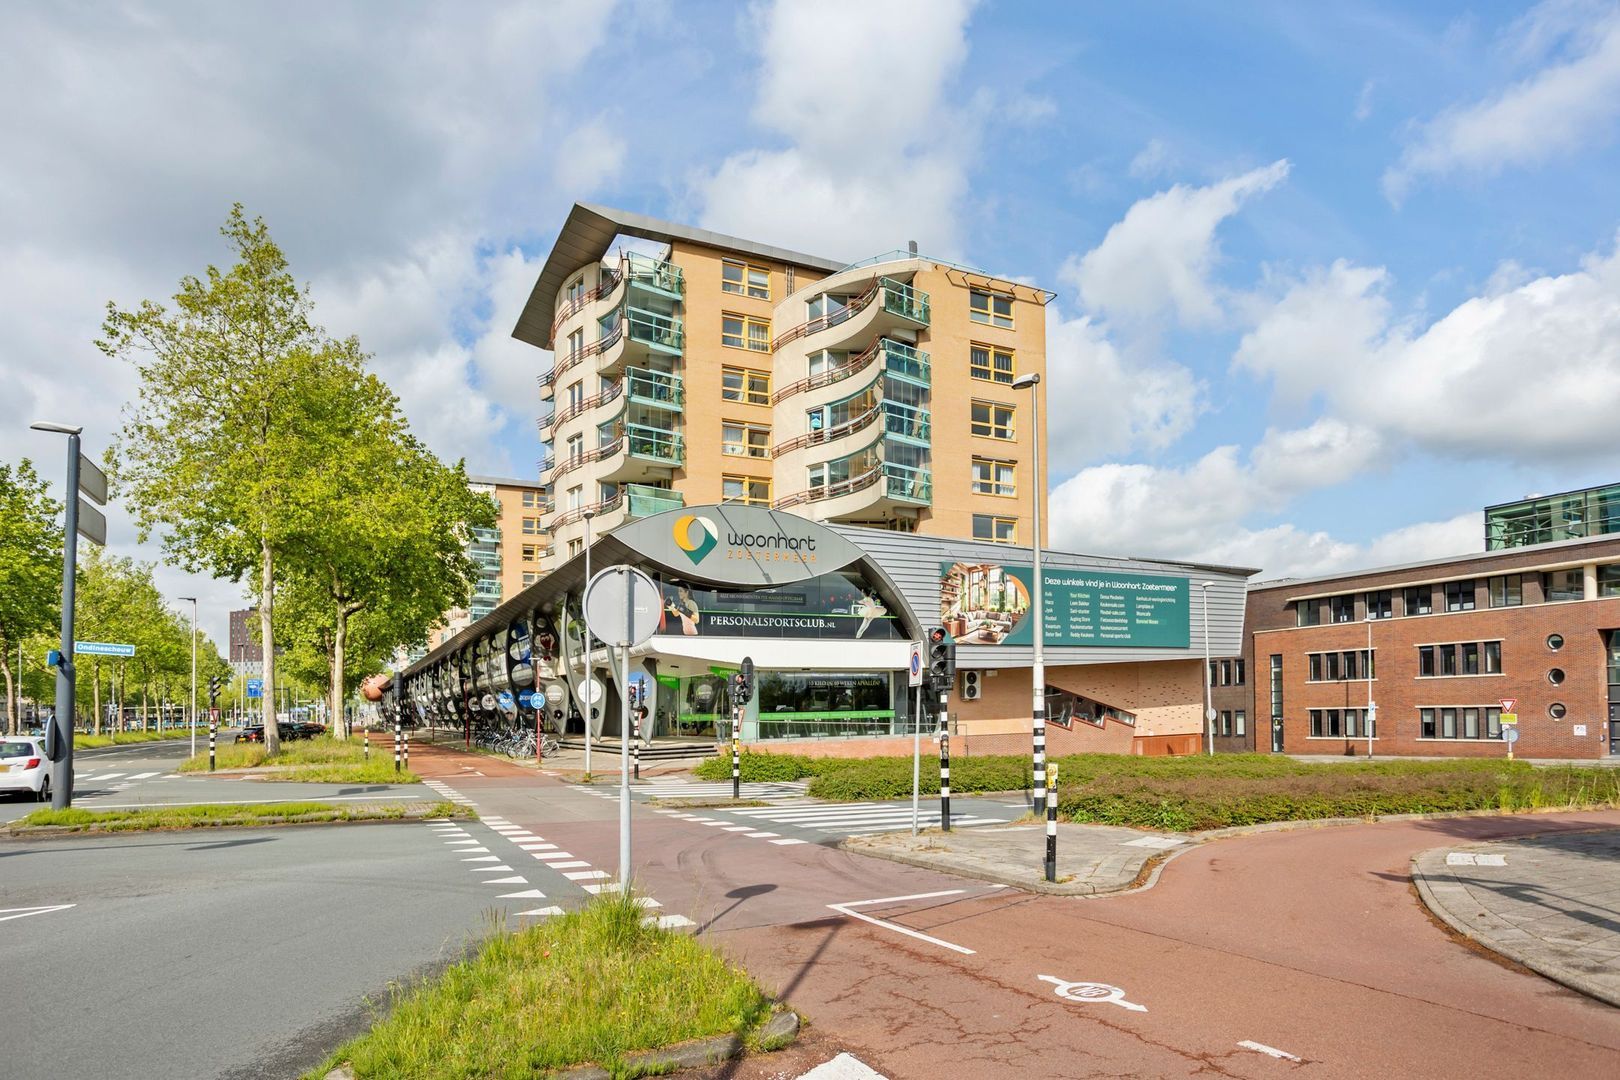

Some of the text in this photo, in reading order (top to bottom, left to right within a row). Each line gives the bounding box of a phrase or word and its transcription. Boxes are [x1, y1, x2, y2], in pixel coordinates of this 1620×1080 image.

[728, 532, 816, 551] woonhart
[727, 548, 816, 564] ZOETERMEER
[1045, 577, 1061, 585] Deze
[1062, 578, 1084, 587] winkels
[1085, 579, 1098, 587] vind
[1099, 580, 1104, 589] je
[1142, 583, 1177, 591] Zoetermeer
[710, 615, 836, 628] PERSONALSPORTSCLUB.NL
[77, 644, 131, 653] Ondineschouw
